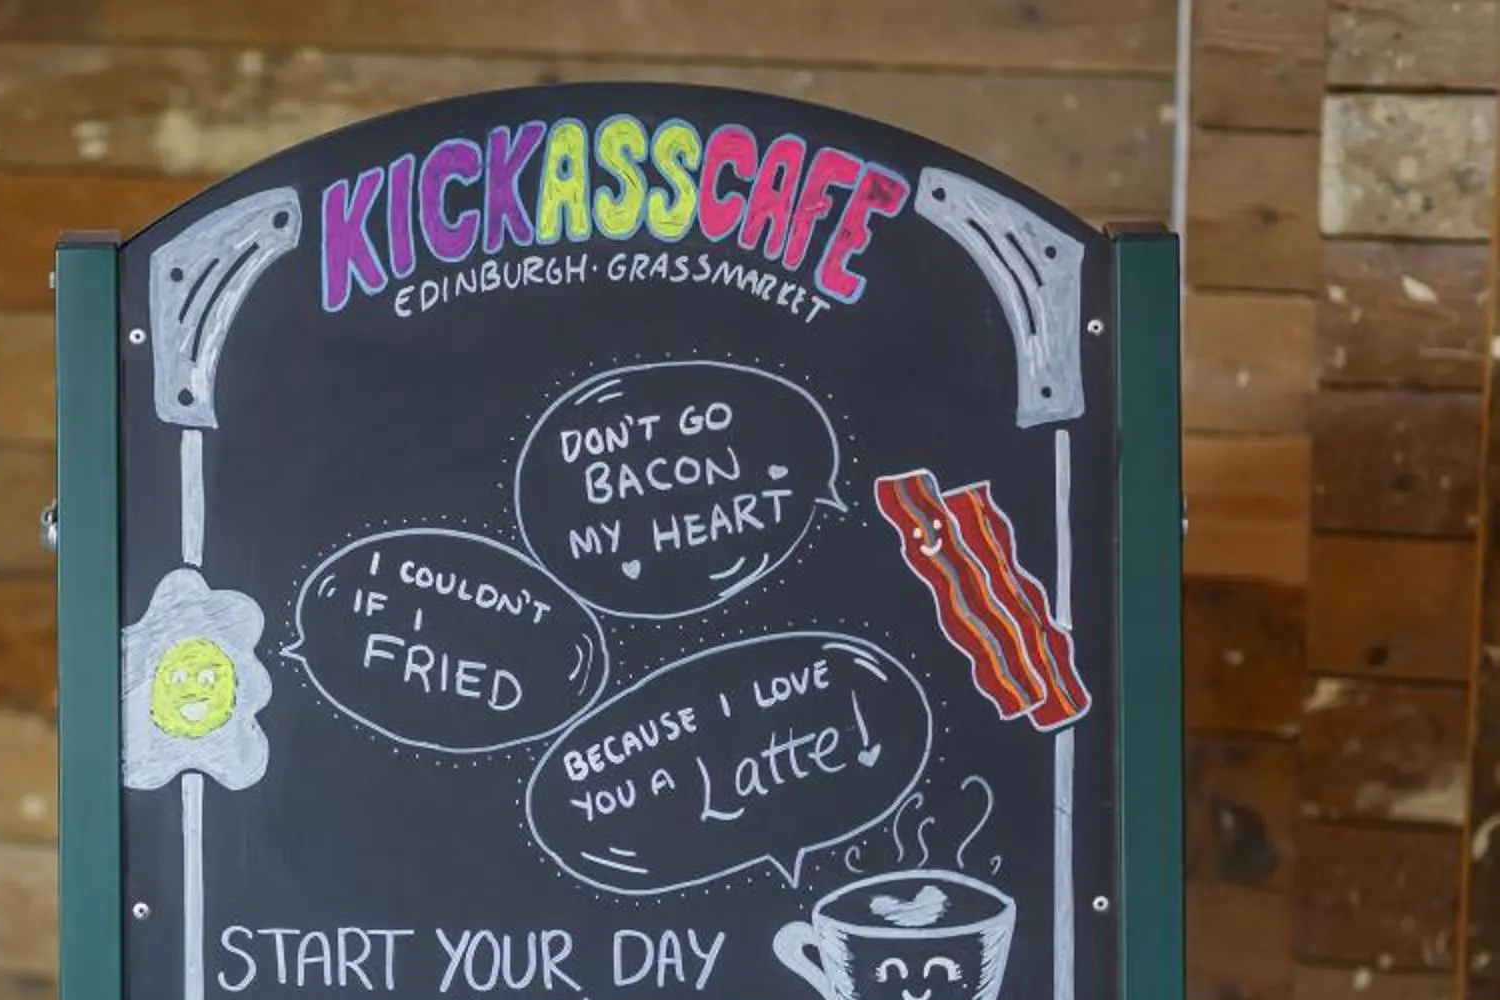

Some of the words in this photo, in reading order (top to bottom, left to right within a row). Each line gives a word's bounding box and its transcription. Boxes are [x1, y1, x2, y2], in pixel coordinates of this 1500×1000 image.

[394, 253, 586, 317] EDINBURGH
[608, 254, 832, 324] GRASSMARKET
[561, 415, 660, 463] DON'T
[679, 402, 732, 435] GO
[586, 447, 740, 504] BACON
[569, 520, 621, 559] MY
[653, 489, 793, 552] HEART
[353, 588, 388, 617] IF
[369, 551, 381, 576] I
[400, 560, 551, 624] COULDN'T
[413, 607, 423, 632] I
[363, 633, 522, 711] FRIED
[563, 707, 697, 782] BECAUSE
[719, 693, 731, 717] I
[753, 659, 830, 708] LOVE
[570, 779, 636, 822] YOU
[651, 768, 676, 796] A
[217, 925, 415, 992] START
[435, 928, 583, 993] YOUR
[613, 929, 726, 990] DAY
